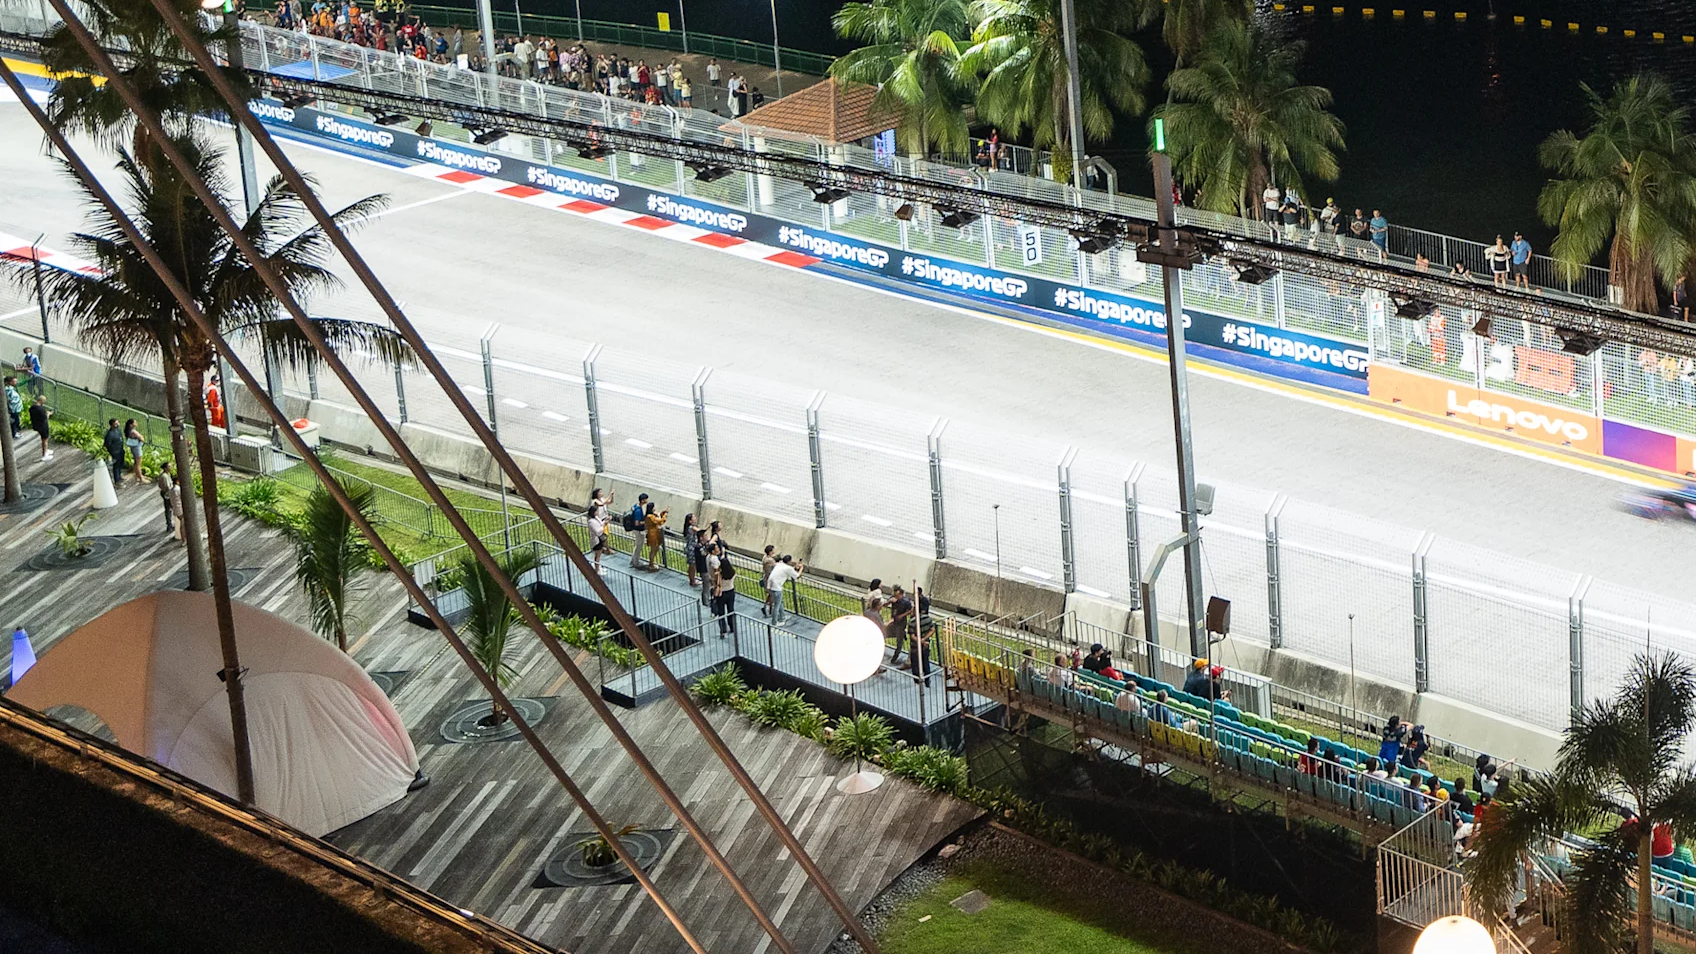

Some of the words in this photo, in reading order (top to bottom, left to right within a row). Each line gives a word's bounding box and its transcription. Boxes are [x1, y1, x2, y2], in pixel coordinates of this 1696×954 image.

[316, 115, 394, 148] #SingaporeGP
[417, 139, 502, 174] #SingaporeGP
[527, 166, 619, 202] #SingaporeGP
[647, 193, 747, 233] #SingaporeGP
[778, 225, 889, 269] #SingaporeGP
[1025, 231, 1037, 261] 50
[901, 255, 1028, 298] #SingaporeGP
[1053, 286, 1192, 330] #SingaporeP
[1446, 389, 1588, 441] Lenovo
